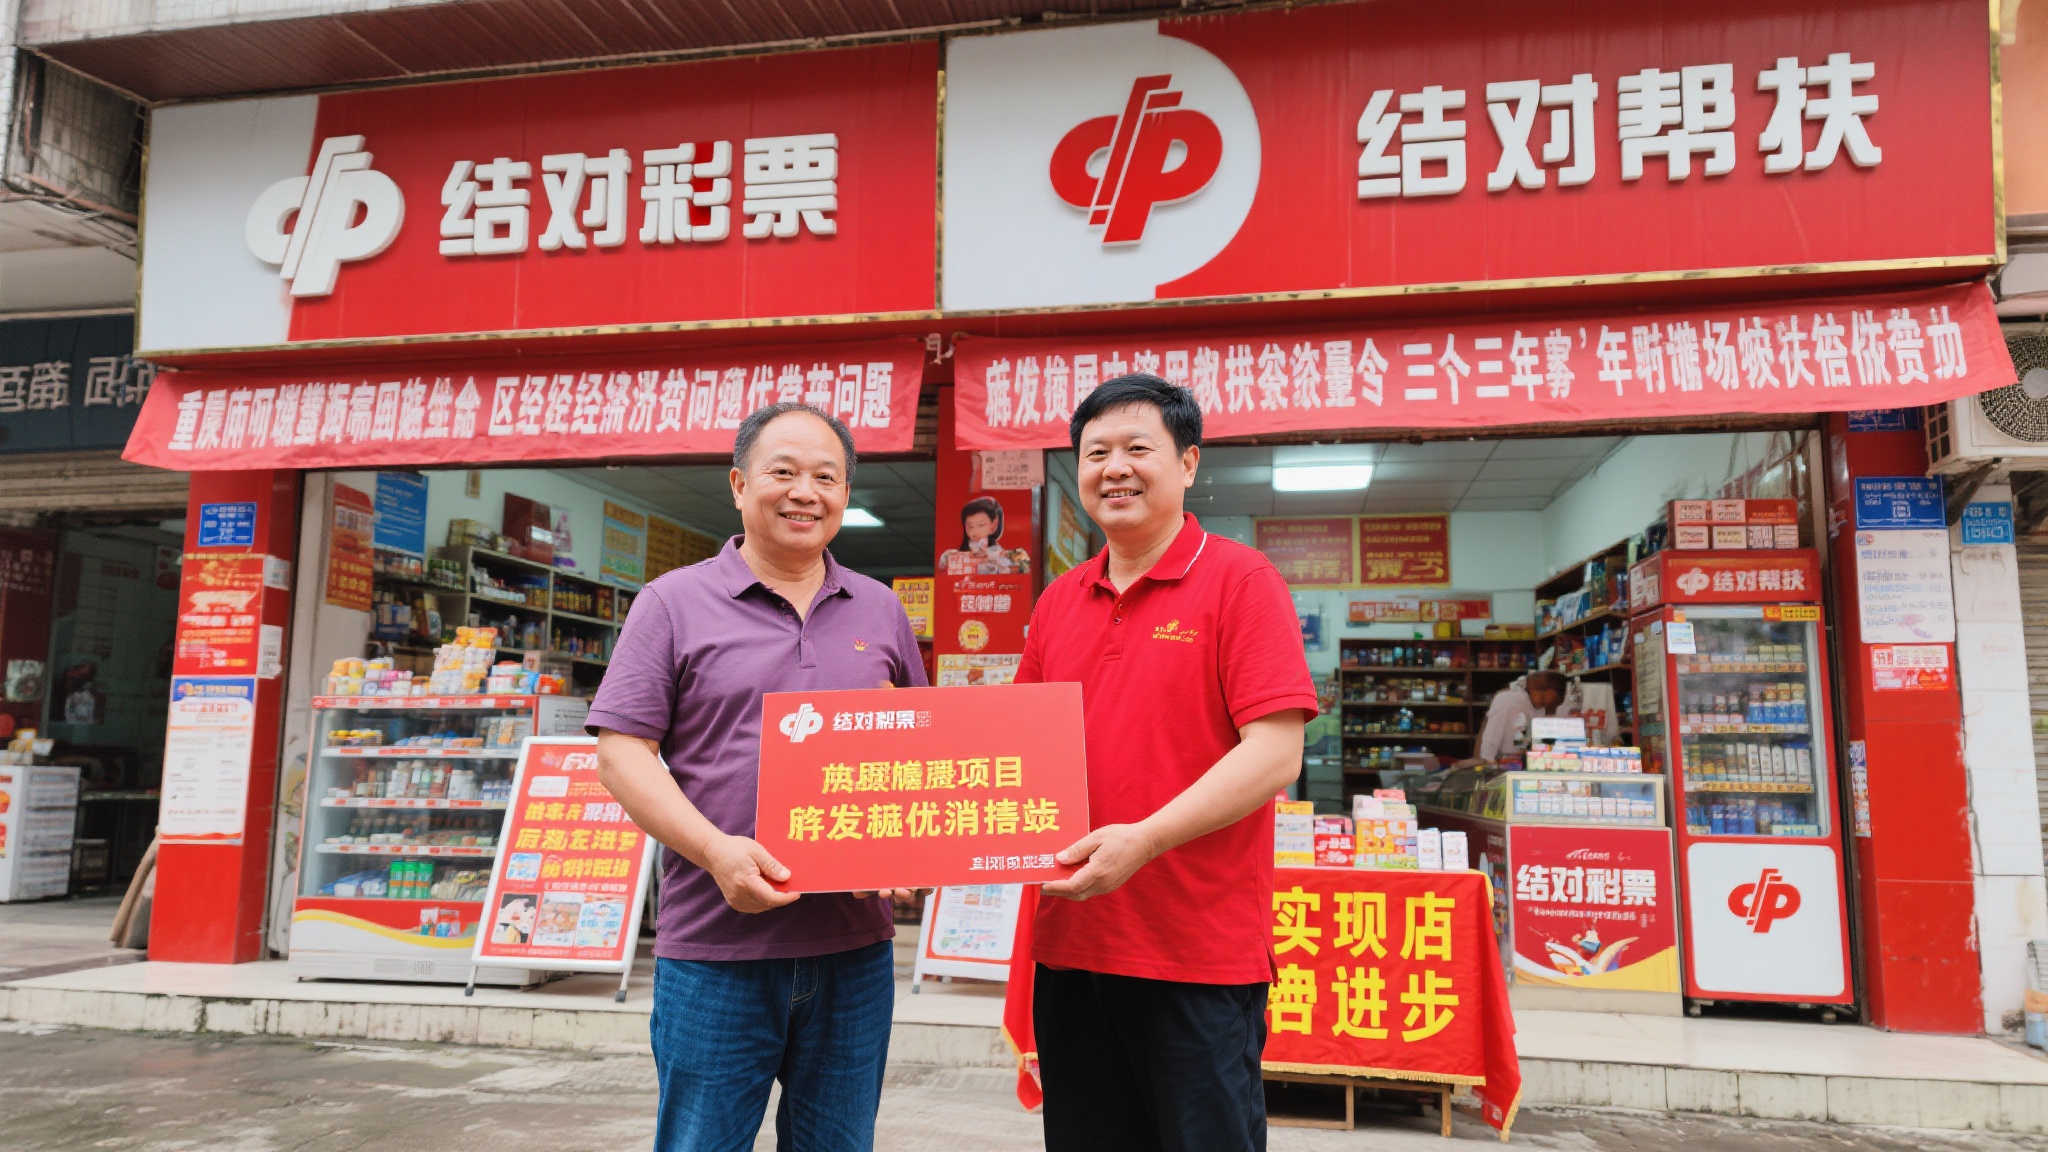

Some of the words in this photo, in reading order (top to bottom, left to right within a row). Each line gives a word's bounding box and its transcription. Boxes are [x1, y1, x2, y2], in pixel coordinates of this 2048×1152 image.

[439, 132, 838, 256] 结对彩票
[1356, 52, 1883, 200] 结对帮扶
